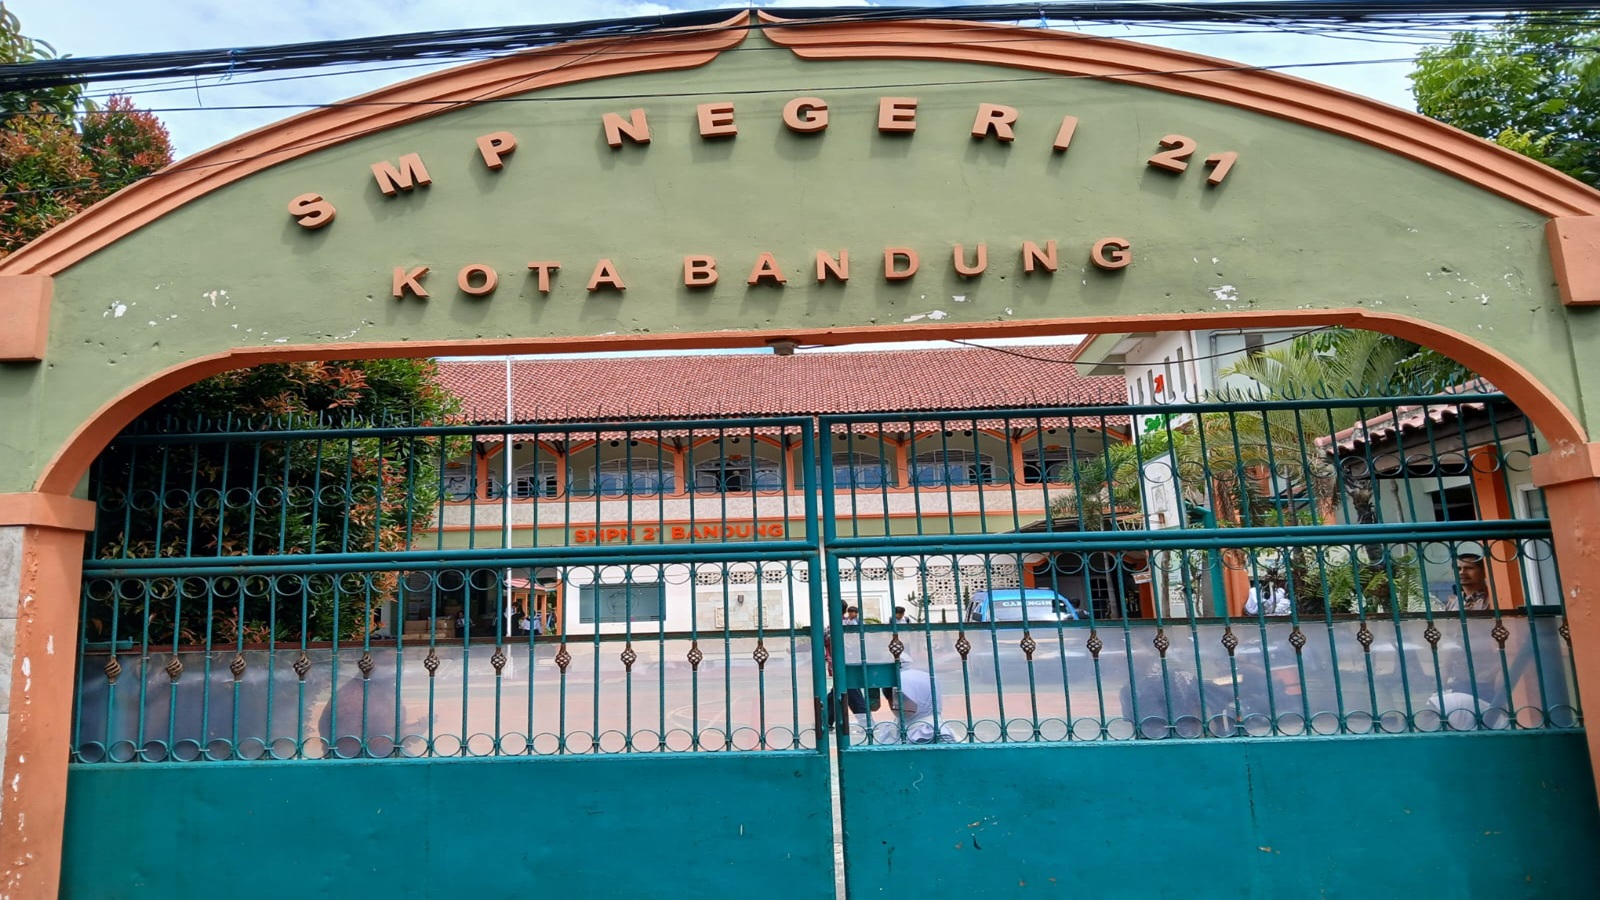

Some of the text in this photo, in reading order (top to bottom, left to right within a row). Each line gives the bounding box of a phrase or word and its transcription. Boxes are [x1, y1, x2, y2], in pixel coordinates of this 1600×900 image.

[288, 98, 1238, 228] SMP NEGERI 21
[392, 238, 1132, 298] KOTA BANDUNG
[575, 528, 635, 543] SMPN
[671, 523, 783, 539] BANDUNG
